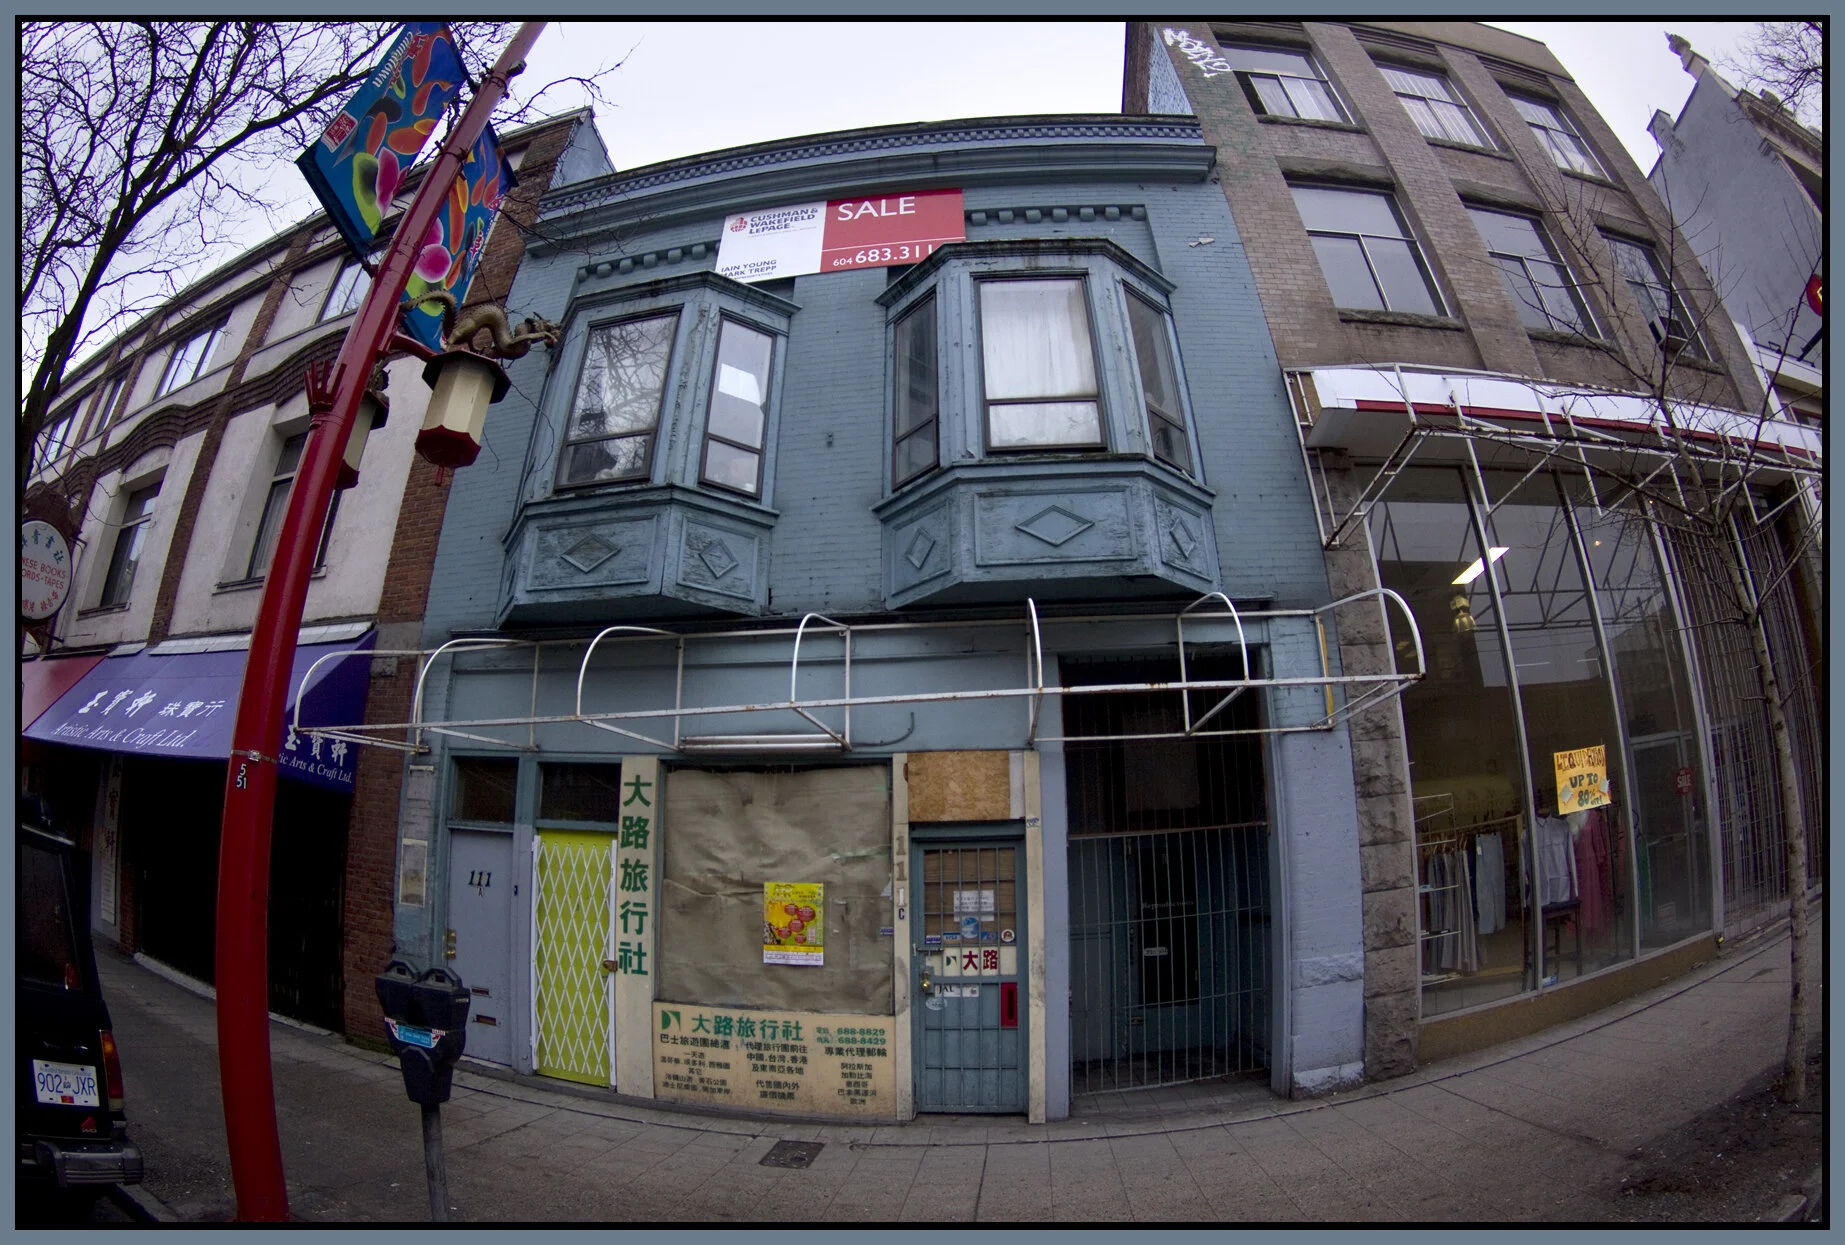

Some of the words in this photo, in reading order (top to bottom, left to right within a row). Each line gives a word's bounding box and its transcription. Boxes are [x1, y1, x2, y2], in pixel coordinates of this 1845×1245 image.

[750, 208, 809, 222] CUSHMAN
[838, 196, 916, 221] SALE
[750, 214, 815, 228] WAKEFIELD
[743, 259, 777, 269] YOUNG
[749, 265, 777, 274] TREPP
[833, 257, 852, 267] 604
[40, 563, 66, 580] BOOKS
[51, 722, 89, 738] Artistic
[84, 725, 112, 742] Arts
[109, 728, 127, 743] &
[122, 727, 162, 749] Craft
[156, 729, 198, 748] Ltd.
[239, 763, 247, 776] 5
[289, 755, 307, 770] Arts
[308, 763, 315, 773] &
[317, 764, 338, 781] Craft
[338, 770, 352, 784] Ltd.
[236, 775, 247, 789] 51
[1569, 774, 1586, 788] UP
[1586, 772, 1599, 786] TO
[468, 870, 492, 887] 111
[618, 774, 653, 976] 大路旅行社
[962, 950, 998, 970] 大路
[691, 1014, 804, 1041] 大路旅行社
[836, 1027, 886, 1036] 688-8829
[838, 1037, 887, 1045] 688-8429
[37, 1072, 64, 1094] 902
[72, 1076, 97, 1097] JXR
